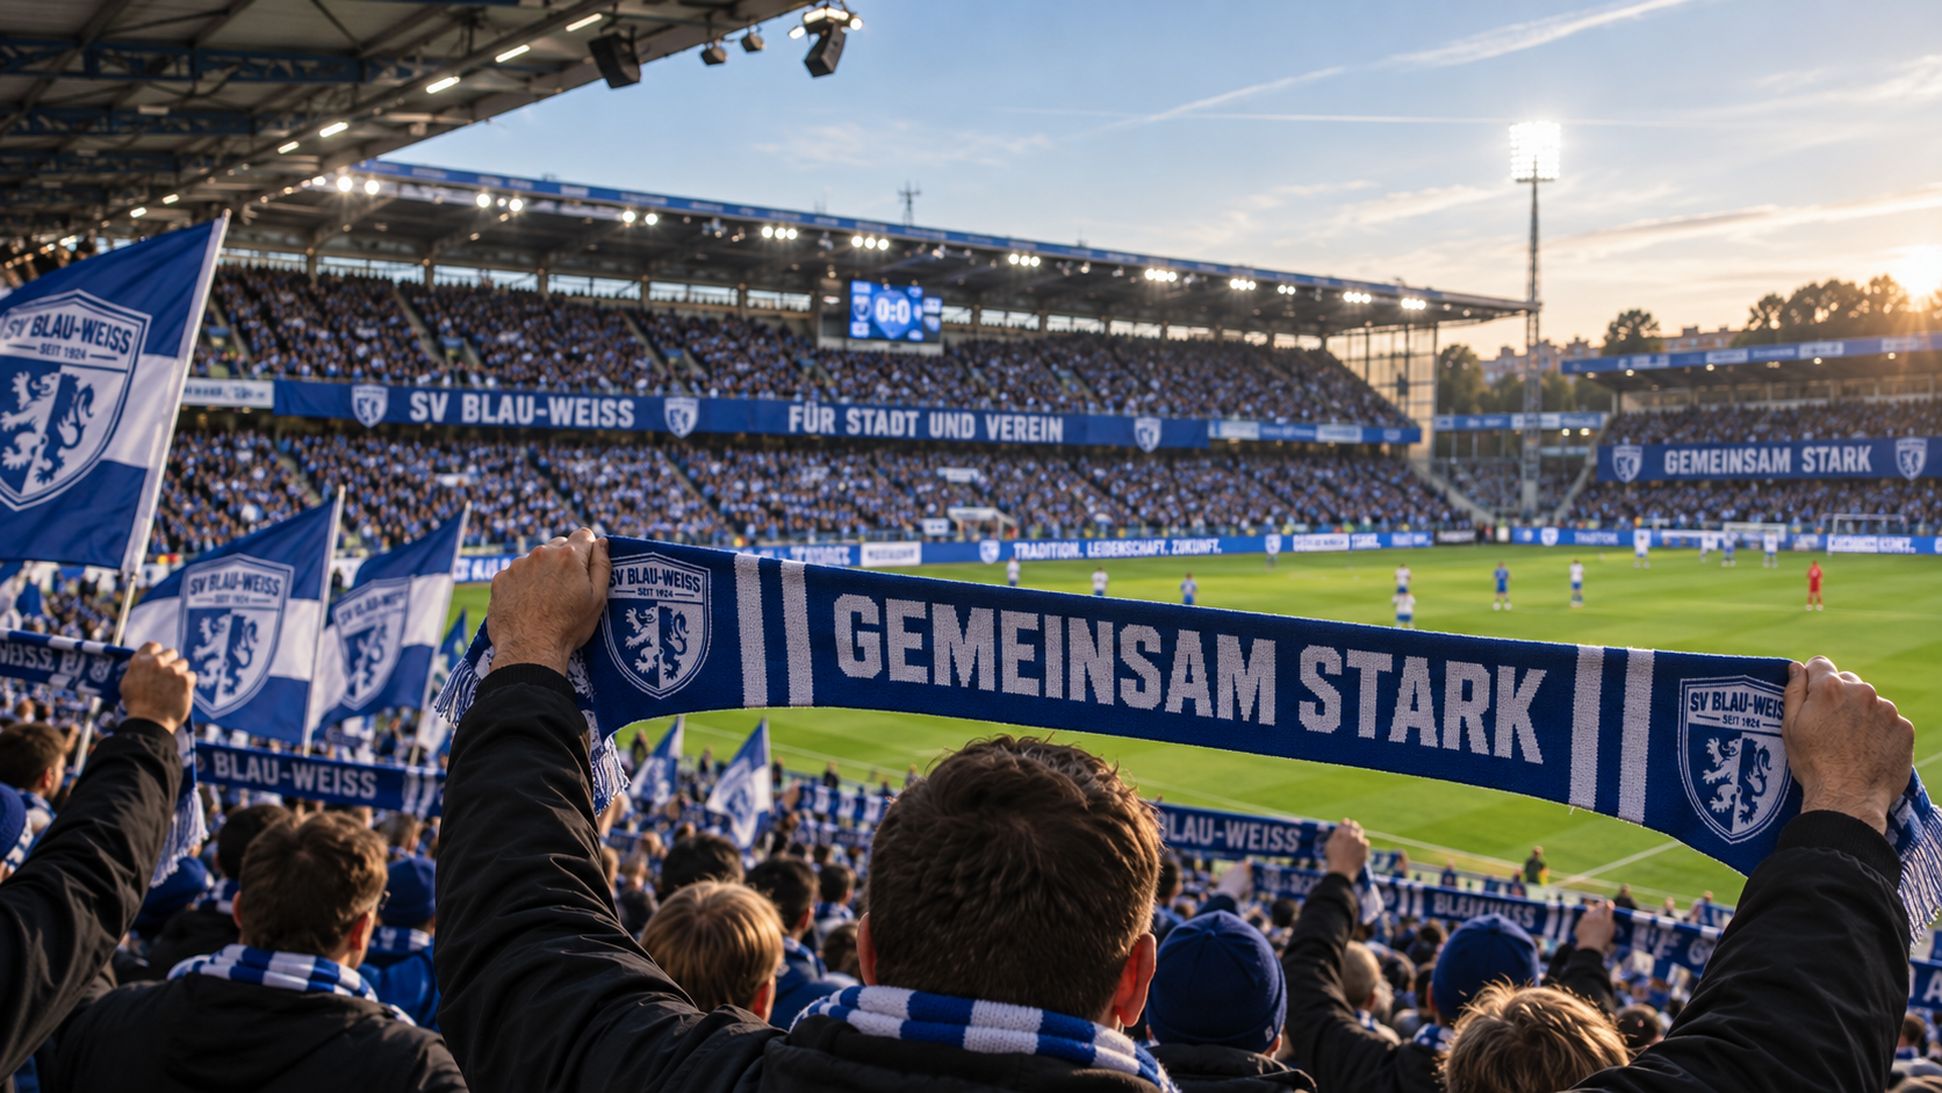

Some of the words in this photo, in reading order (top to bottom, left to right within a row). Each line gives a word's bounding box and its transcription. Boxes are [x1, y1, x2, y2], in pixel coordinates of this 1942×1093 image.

[876, 297, 911, 325] 0:0
[3, 316, 32, 339] SV
[31, 313, 132, 355] BLAU-WEISS
[40, 343, 61, 356] SEIT
[64, 347, 87, 360] 1924
[409, 391, 449, 422] SV
[462, 393, 635, 428] BLAU-WEISS
[788, 402, 836, 434] FÜR
[846, 409, 919, 438] STADT
[929, 412, 975, 439] UND
[986, 414, 1063, 443] VEREIN
[1664, 448, 1792, 475] GEMEINSAM
[1802, 445, 1872, 473] STARK
[190, 577, 206, 596] SV
[208, 572, 280, 597] BLAU-WEISS
[627, 567, 701, 593] BLAU-WEISS
[637, 587, 653, 598] SEIT
[655, 588, 674, 598] 1924
[833, 593, 1277, 726] GEMEINSAM
[1299, 644, 1547, 765] STARK
[1689, 691, 1709, 712] SV
[1711, 691, 1785, 721] BLAU-WEIS
[1722, 714, 1739, 726] SEIT
[213, 751, 377, 800] BLAU-WEISS
